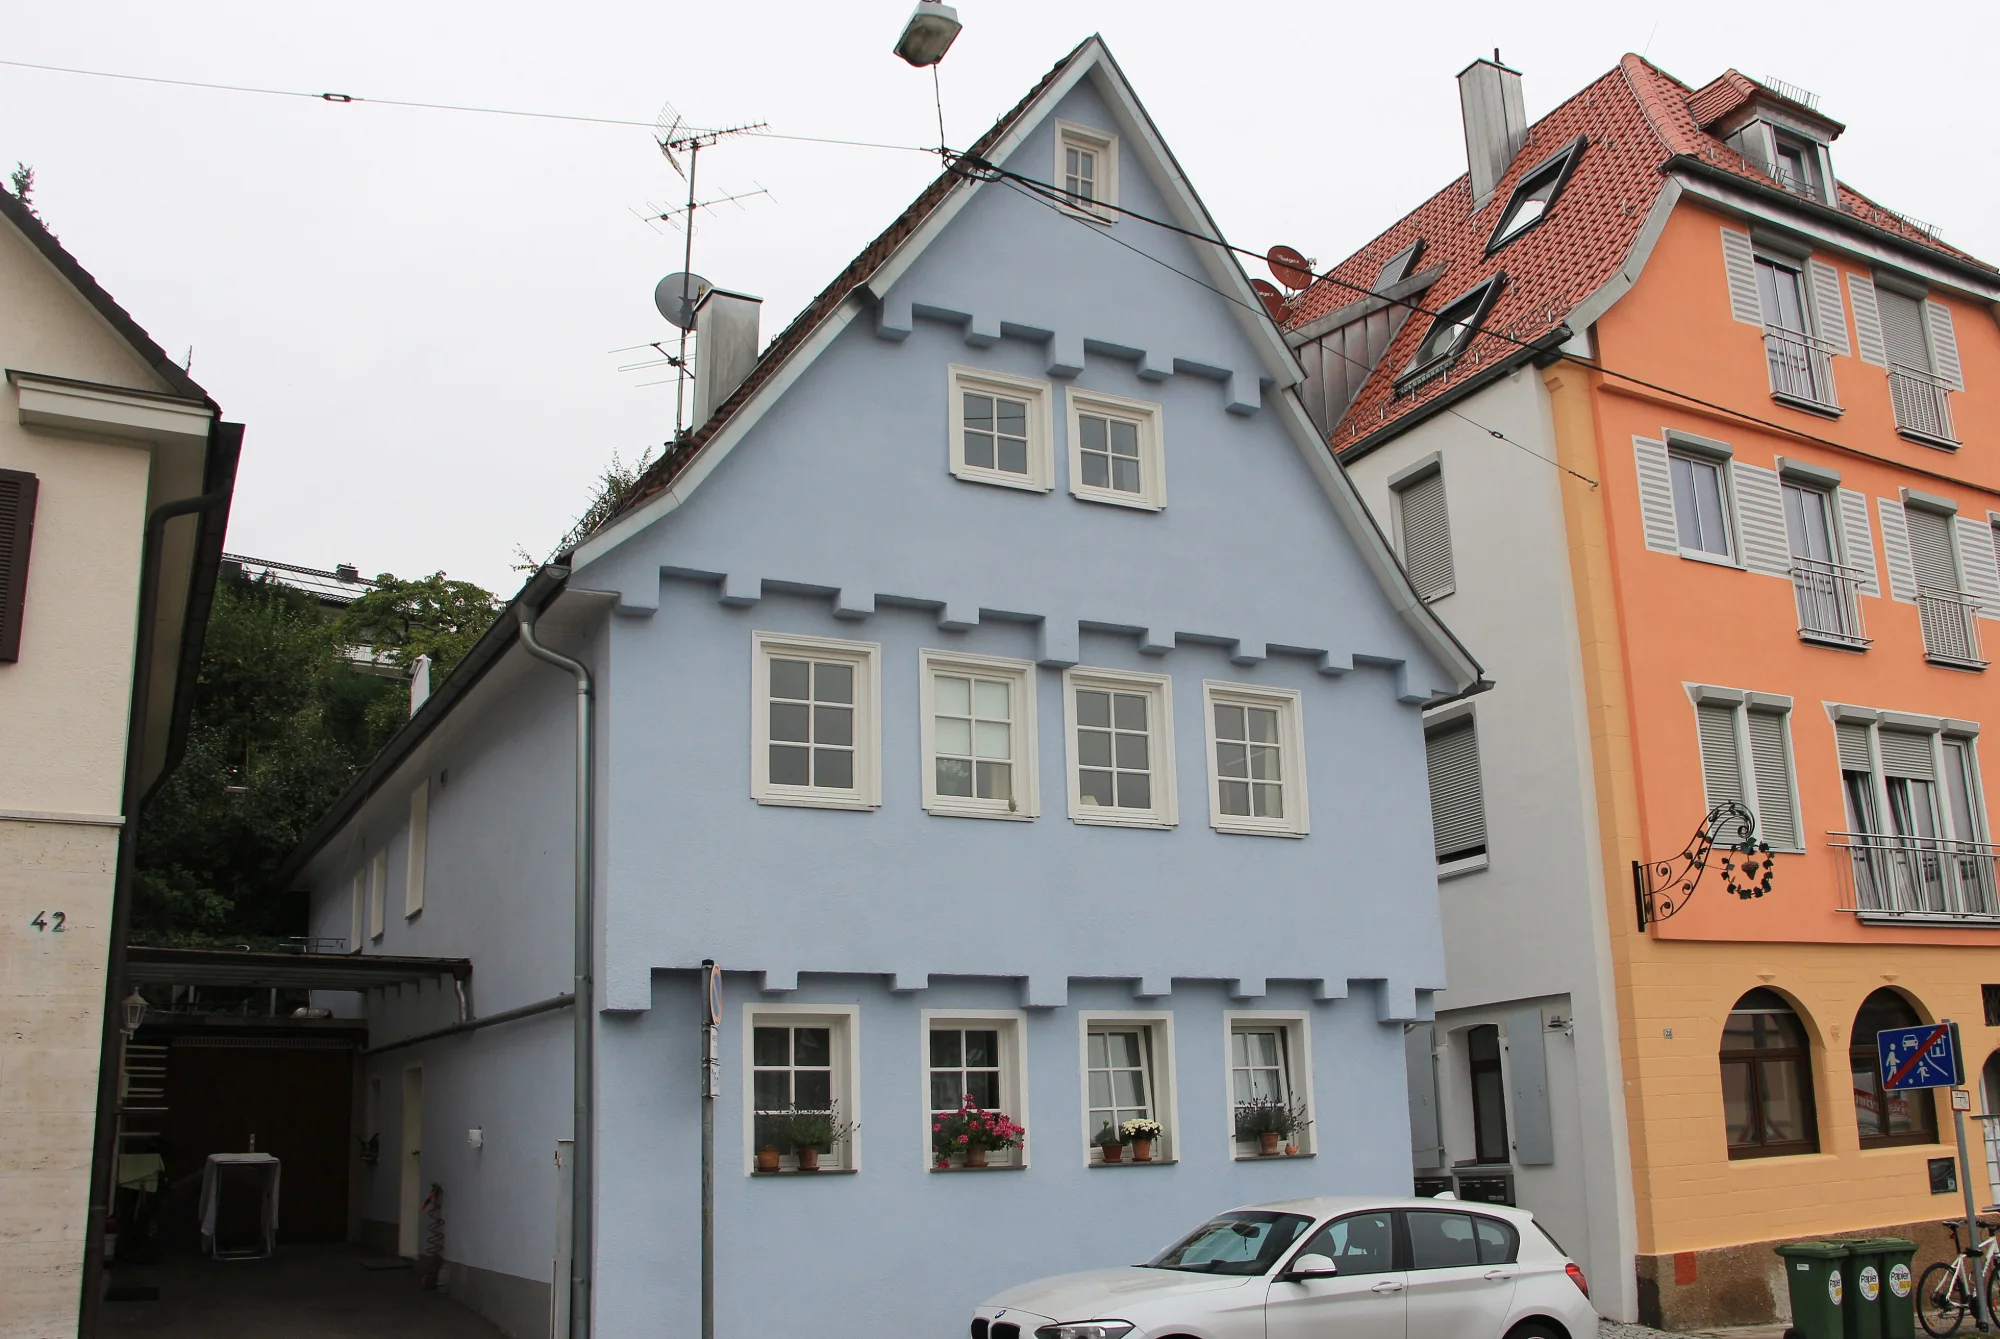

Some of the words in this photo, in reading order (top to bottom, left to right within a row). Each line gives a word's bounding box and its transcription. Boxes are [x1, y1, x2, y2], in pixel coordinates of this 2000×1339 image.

[30, 911, 67, 932] 42
[1861, 1273, 1878, 1284] Papier
[1891, 1271, 1909, 1281] Papier
